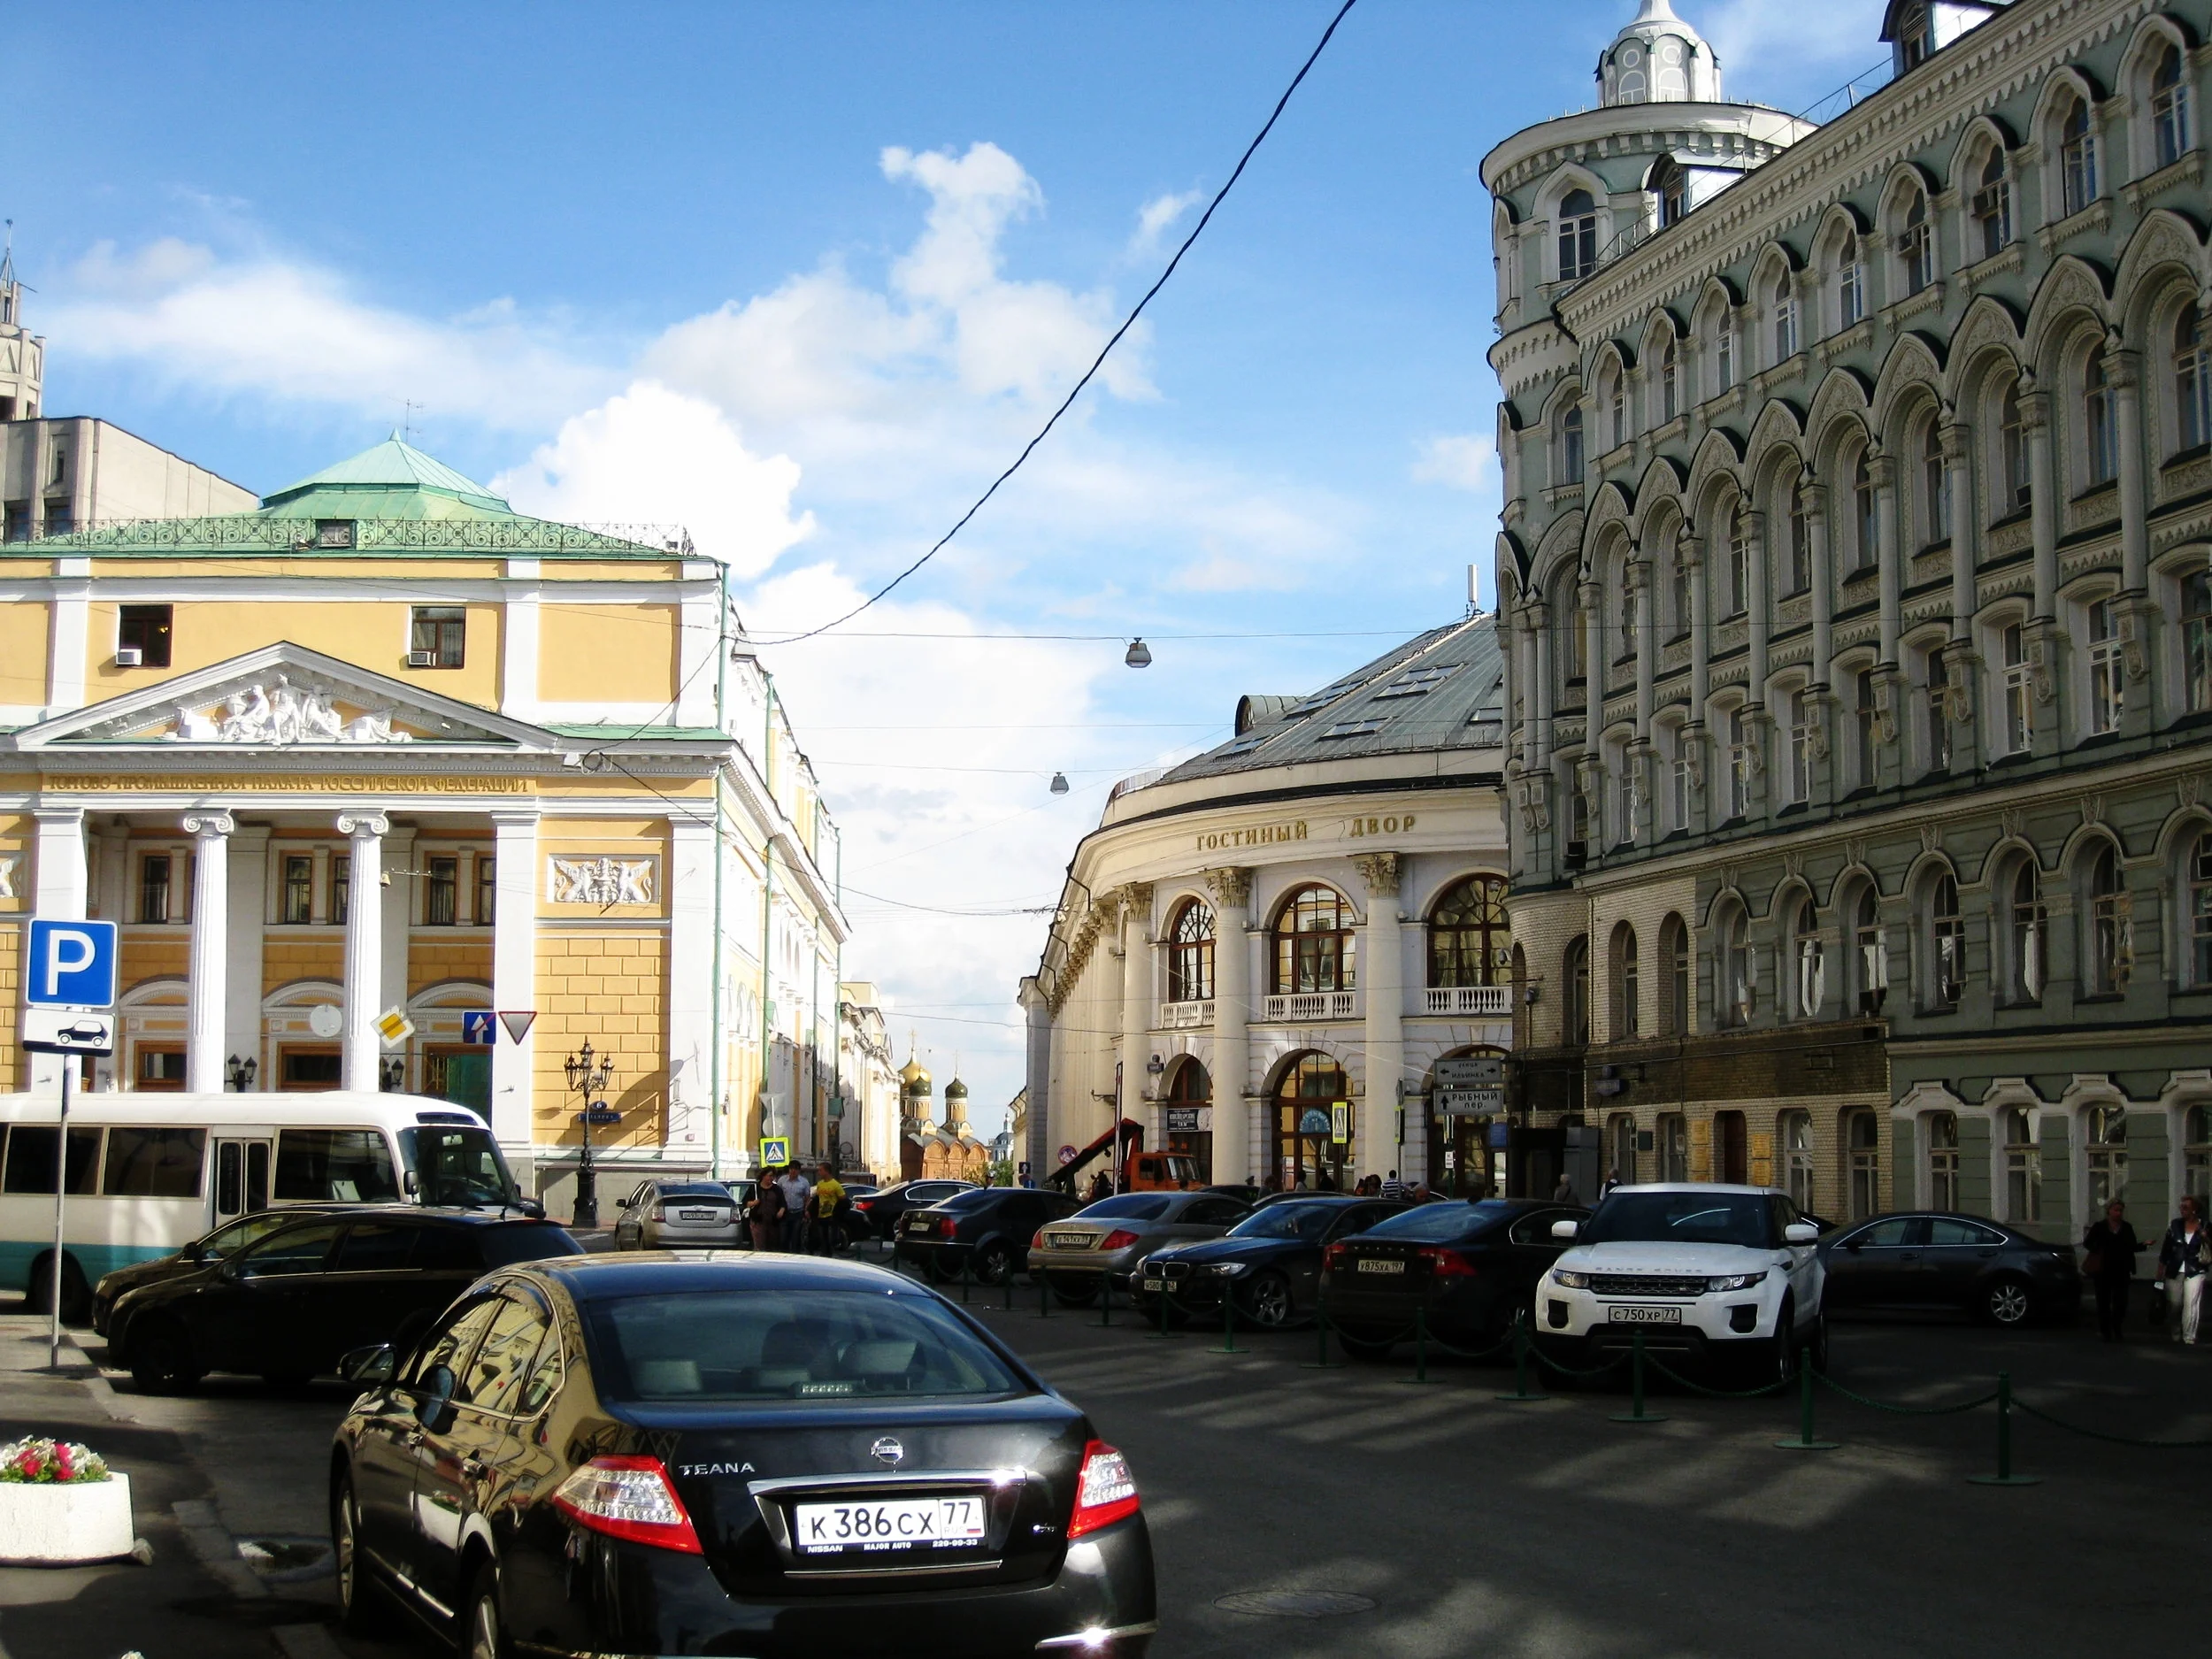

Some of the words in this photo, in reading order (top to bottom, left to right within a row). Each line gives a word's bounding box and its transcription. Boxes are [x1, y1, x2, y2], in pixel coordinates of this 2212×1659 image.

[251, 776, 312, 790] ПАЛАТА
[320, 776, 428, 792] РОССИЙСКОЙ
[434, 777, 529, 793] ФЕДЕРАЦИИ
[1196, 821, 1308, 851] ГОСТИНЫЙ
[1349, 816, 1416, 837] ДВОР
[47, 929, 96, 995] P
[1452, 1092, 1498, 1102] РЫБНЫЙ
[1664, 1309, 1677, 1318] 77
[679, 1463, 755, 1476] TEANA
[943, 1502, 972, 1525] 77
